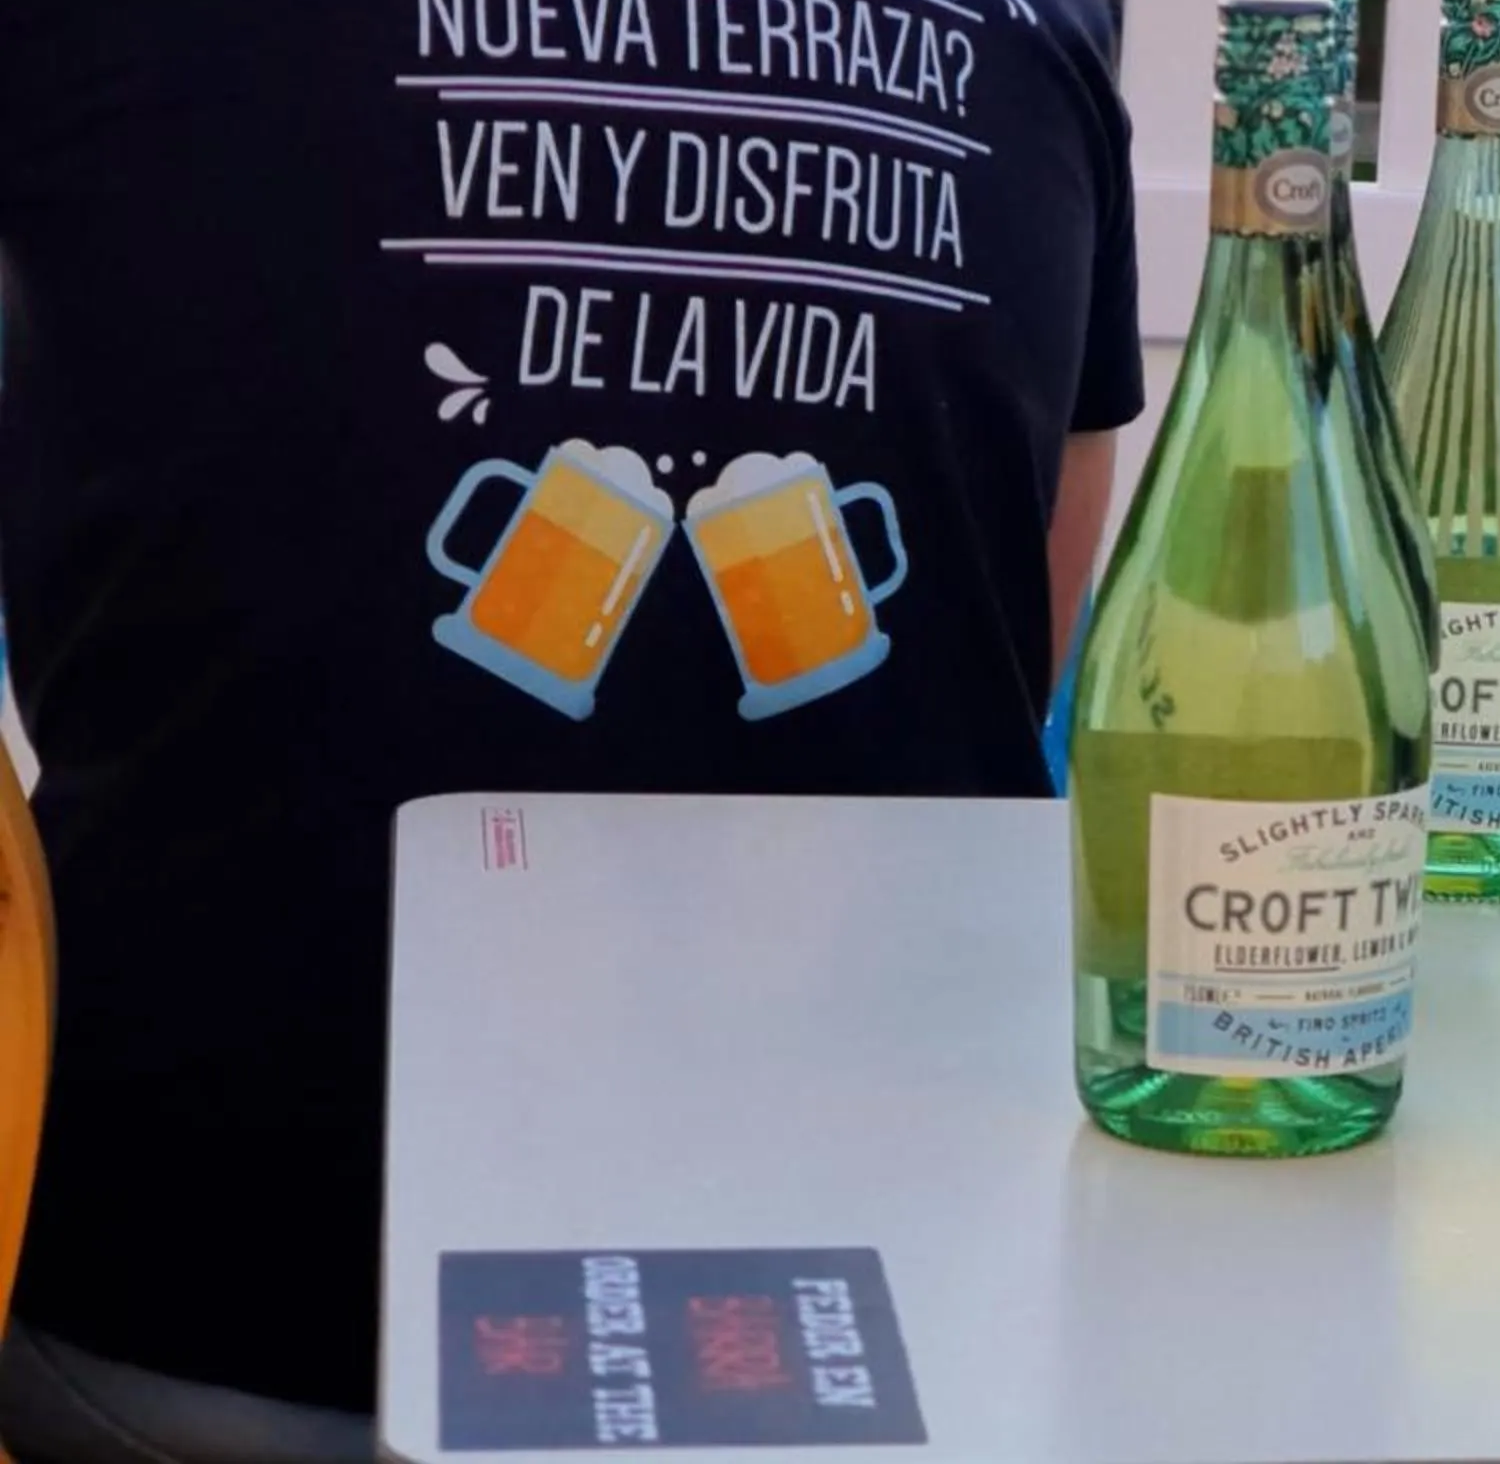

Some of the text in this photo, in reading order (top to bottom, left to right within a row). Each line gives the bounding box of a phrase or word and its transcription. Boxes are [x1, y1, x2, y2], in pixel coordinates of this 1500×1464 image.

[437, 119, 964, 268] VEN Y DISFRUTA
[518, 285, 877, 413] DE LA VIDA
[1219, 802, 1364, 864] SLIGHTLY
[1183, 883, 1358, 935] CROFT
[1211, 1009, 1331, 1070] BRITISH
